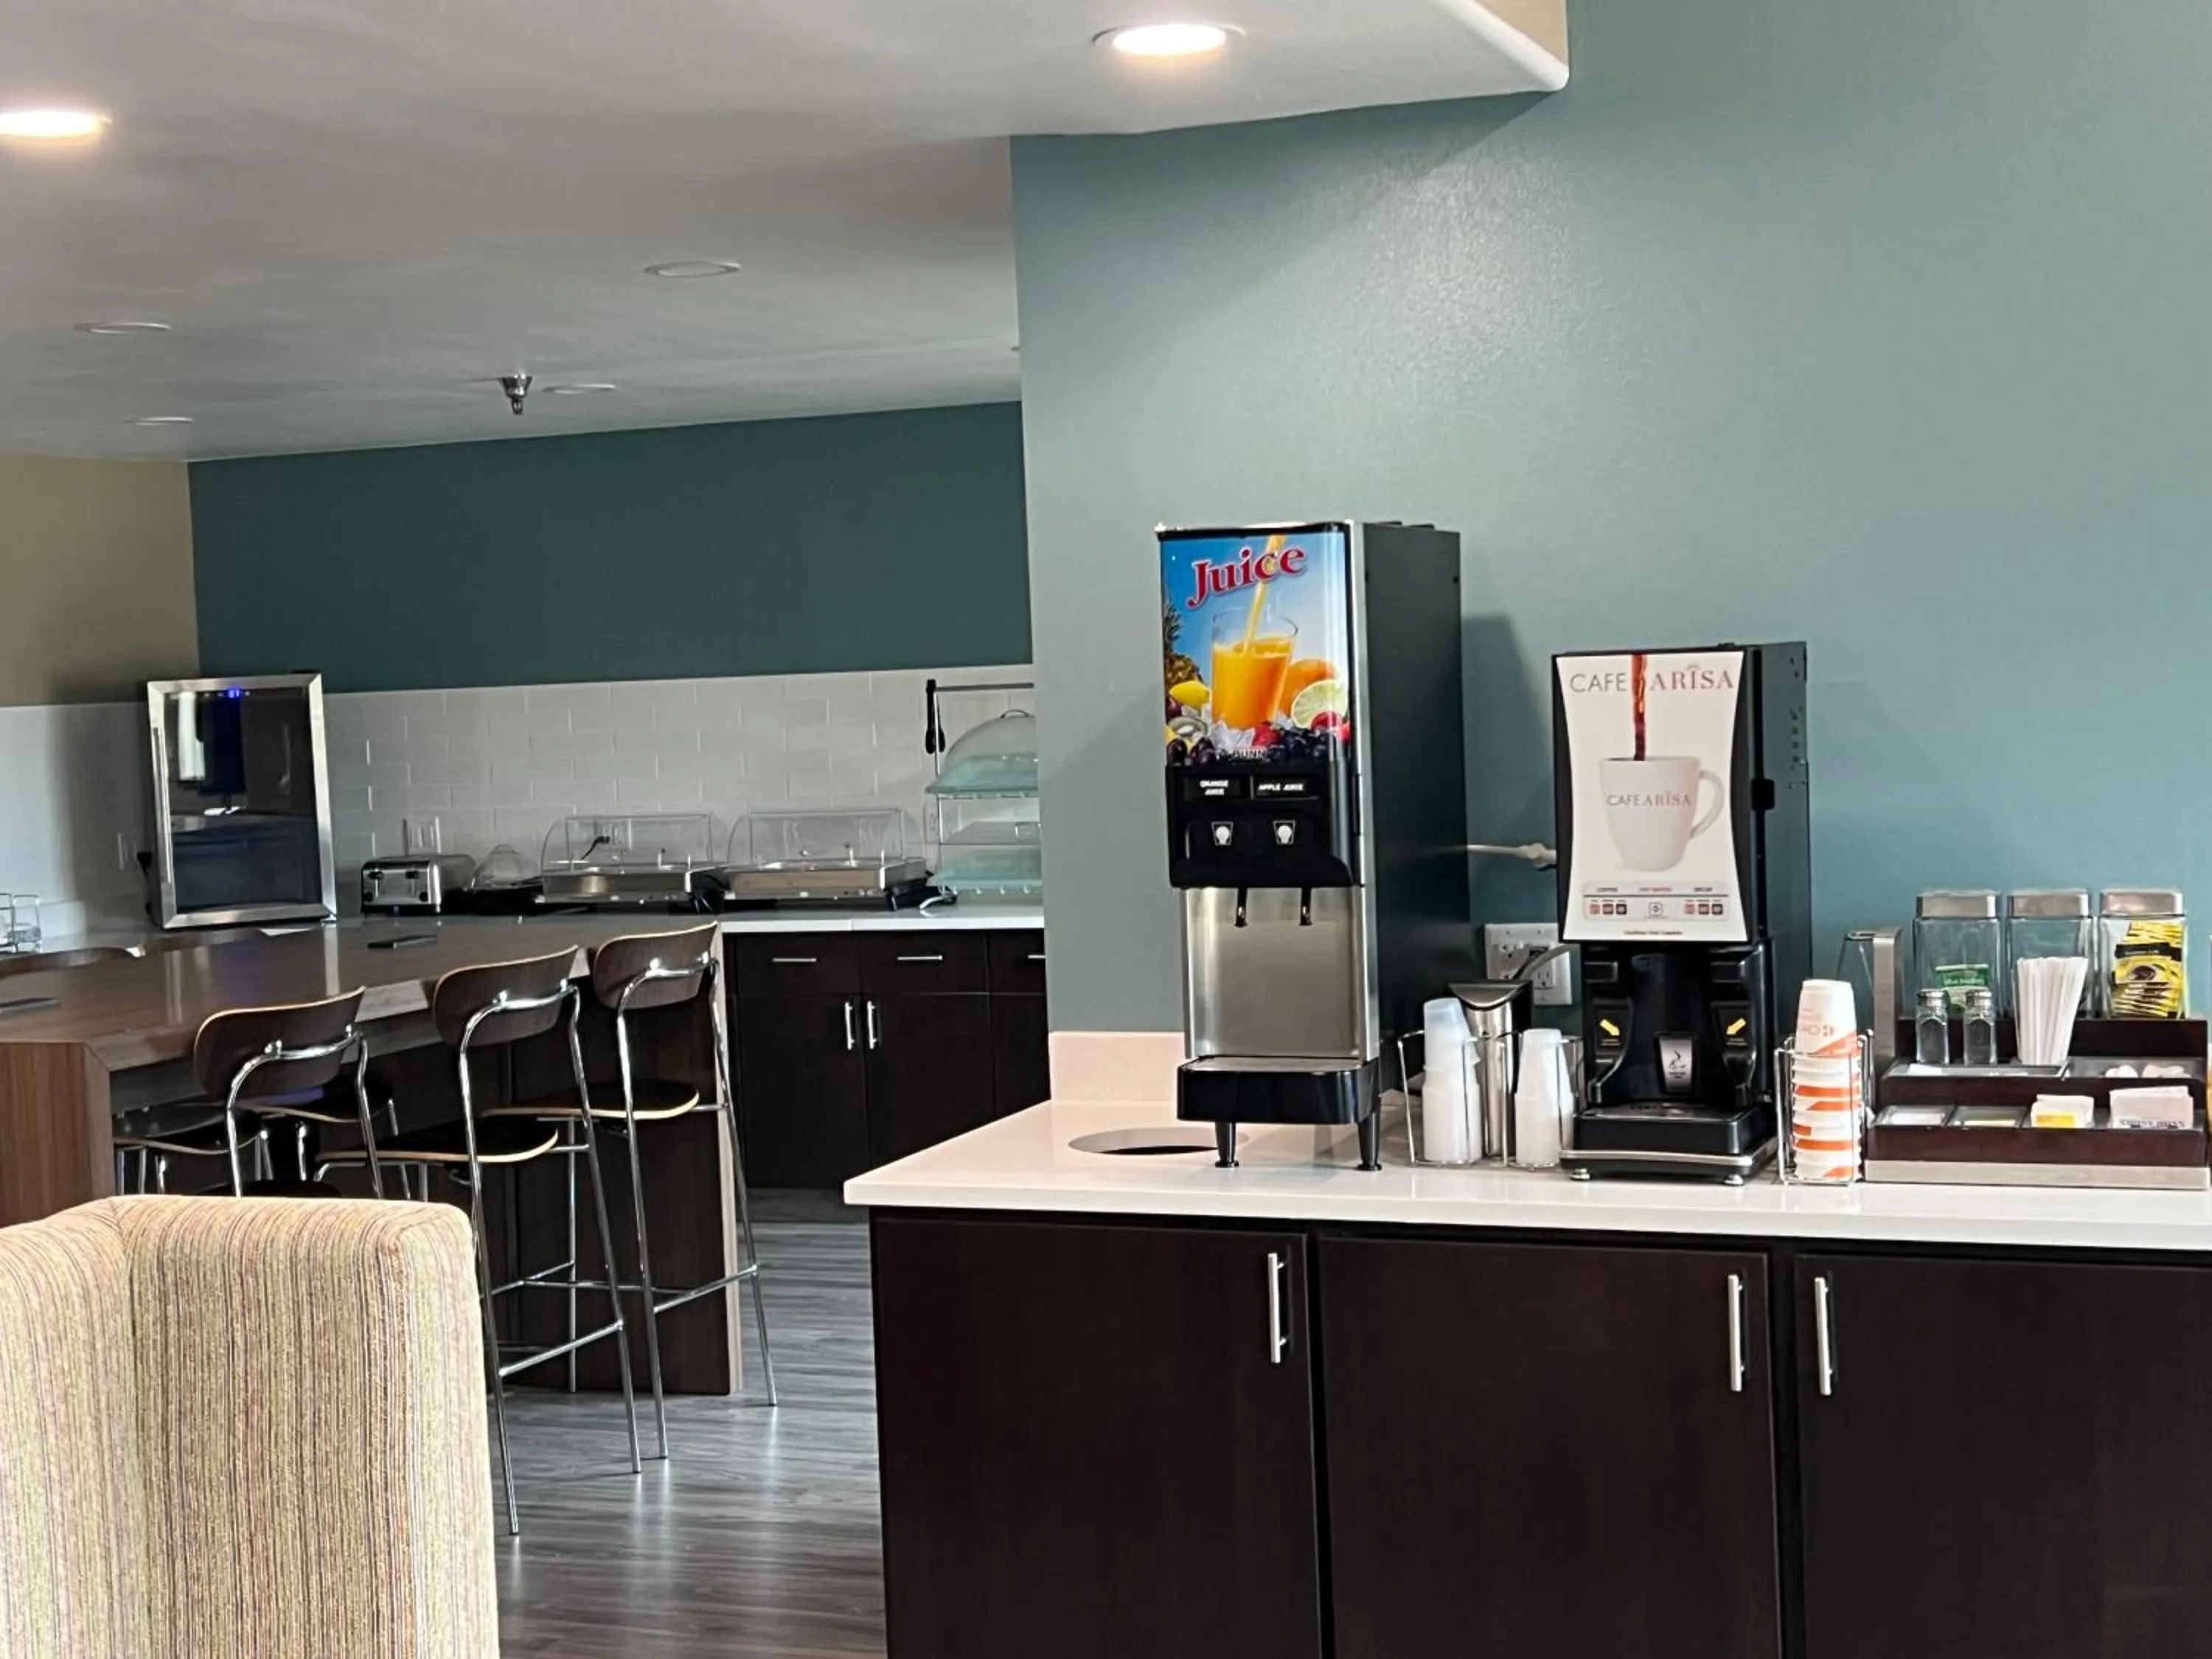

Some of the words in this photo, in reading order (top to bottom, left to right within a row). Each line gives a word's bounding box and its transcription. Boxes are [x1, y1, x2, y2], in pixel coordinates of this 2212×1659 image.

[1186, 546, 1307, 610] Juice
[1569, 672, 1628, 693] CAFE
[1606, 794, 1641, 807] CAFE
